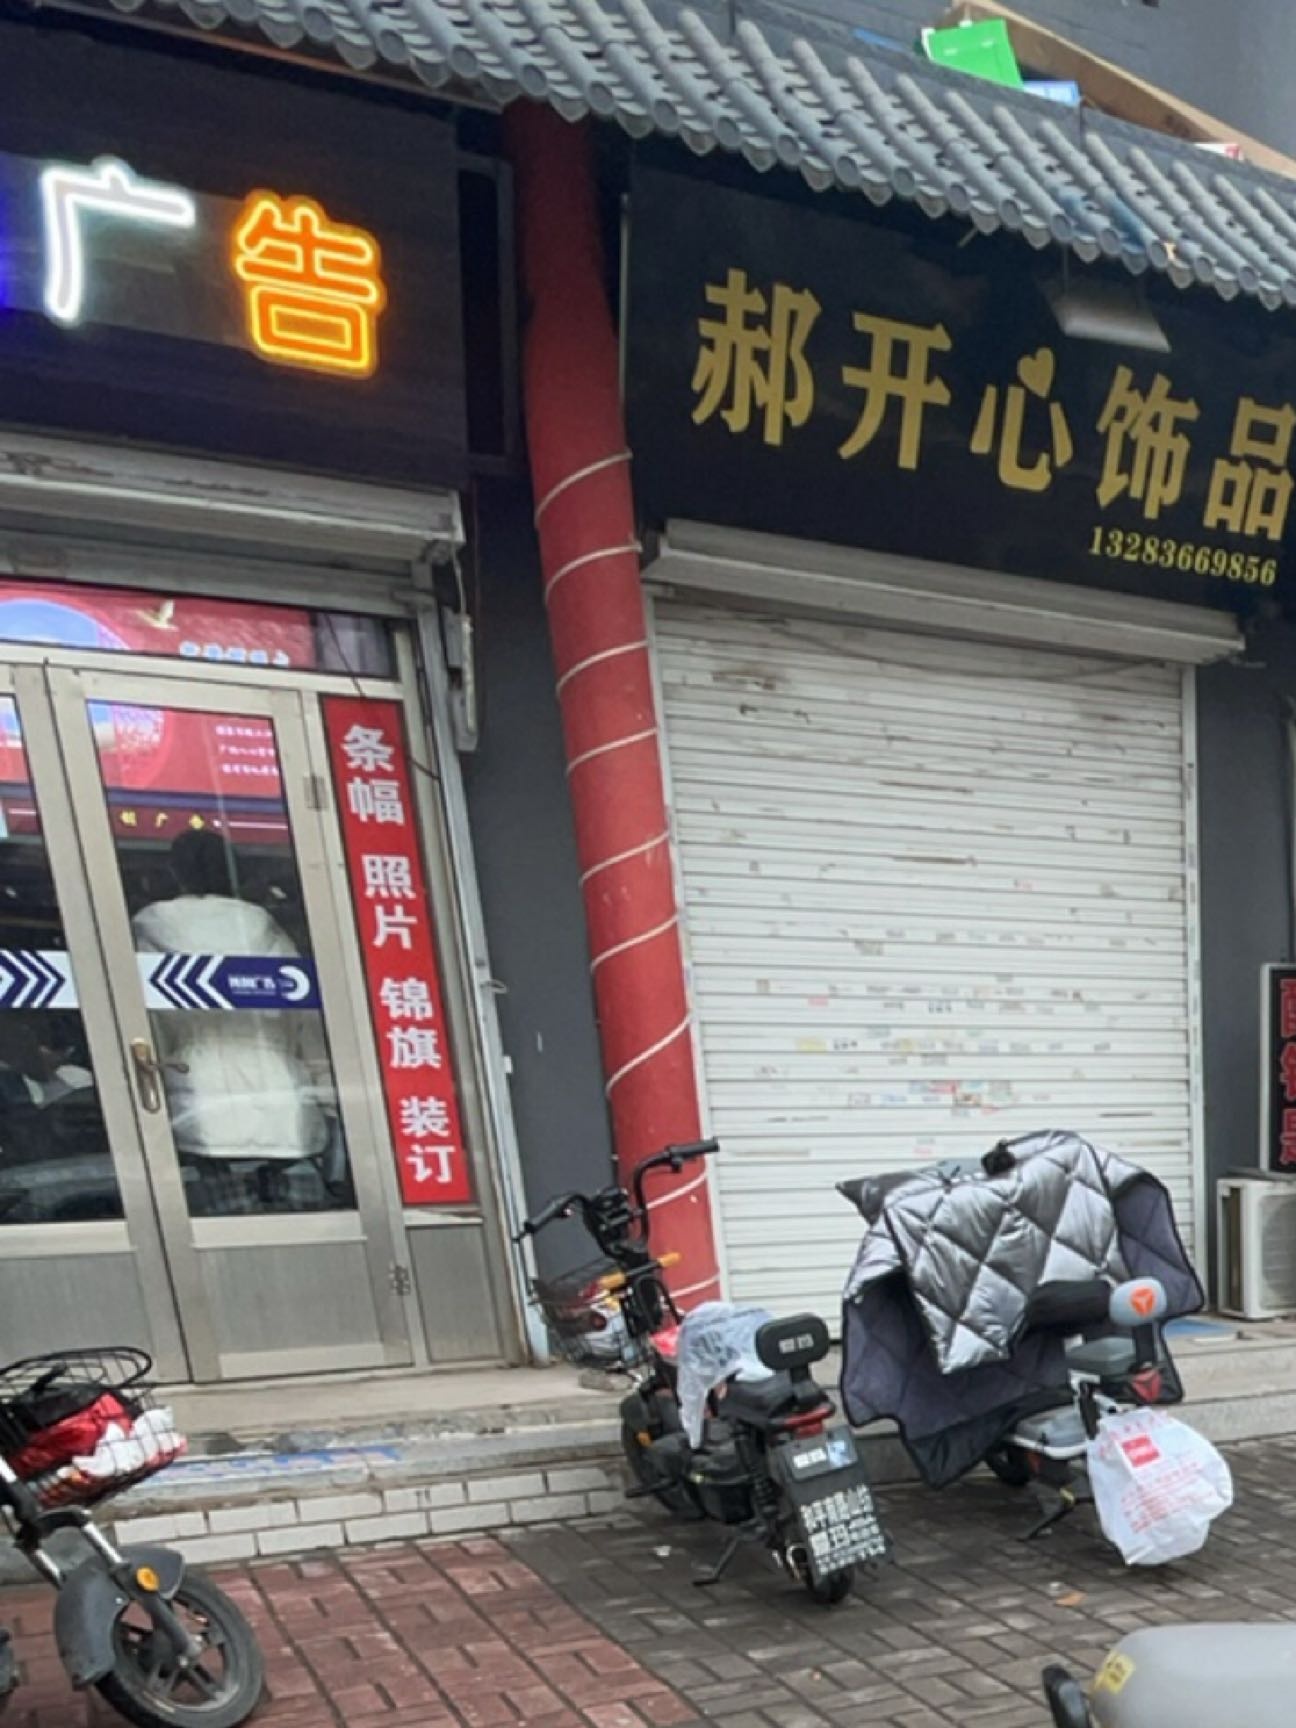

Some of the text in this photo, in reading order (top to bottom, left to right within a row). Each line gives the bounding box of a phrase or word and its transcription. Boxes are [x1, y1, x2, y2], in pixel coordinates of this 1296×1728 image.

[42, 158, 382, 375] 广告
[691, 268, 1296, 541] 郝开心饰品
[1088, 525, 1278, 587] 13283669856
[342, 724, 455, 1185] 条幅 照片 锦旗 装订
